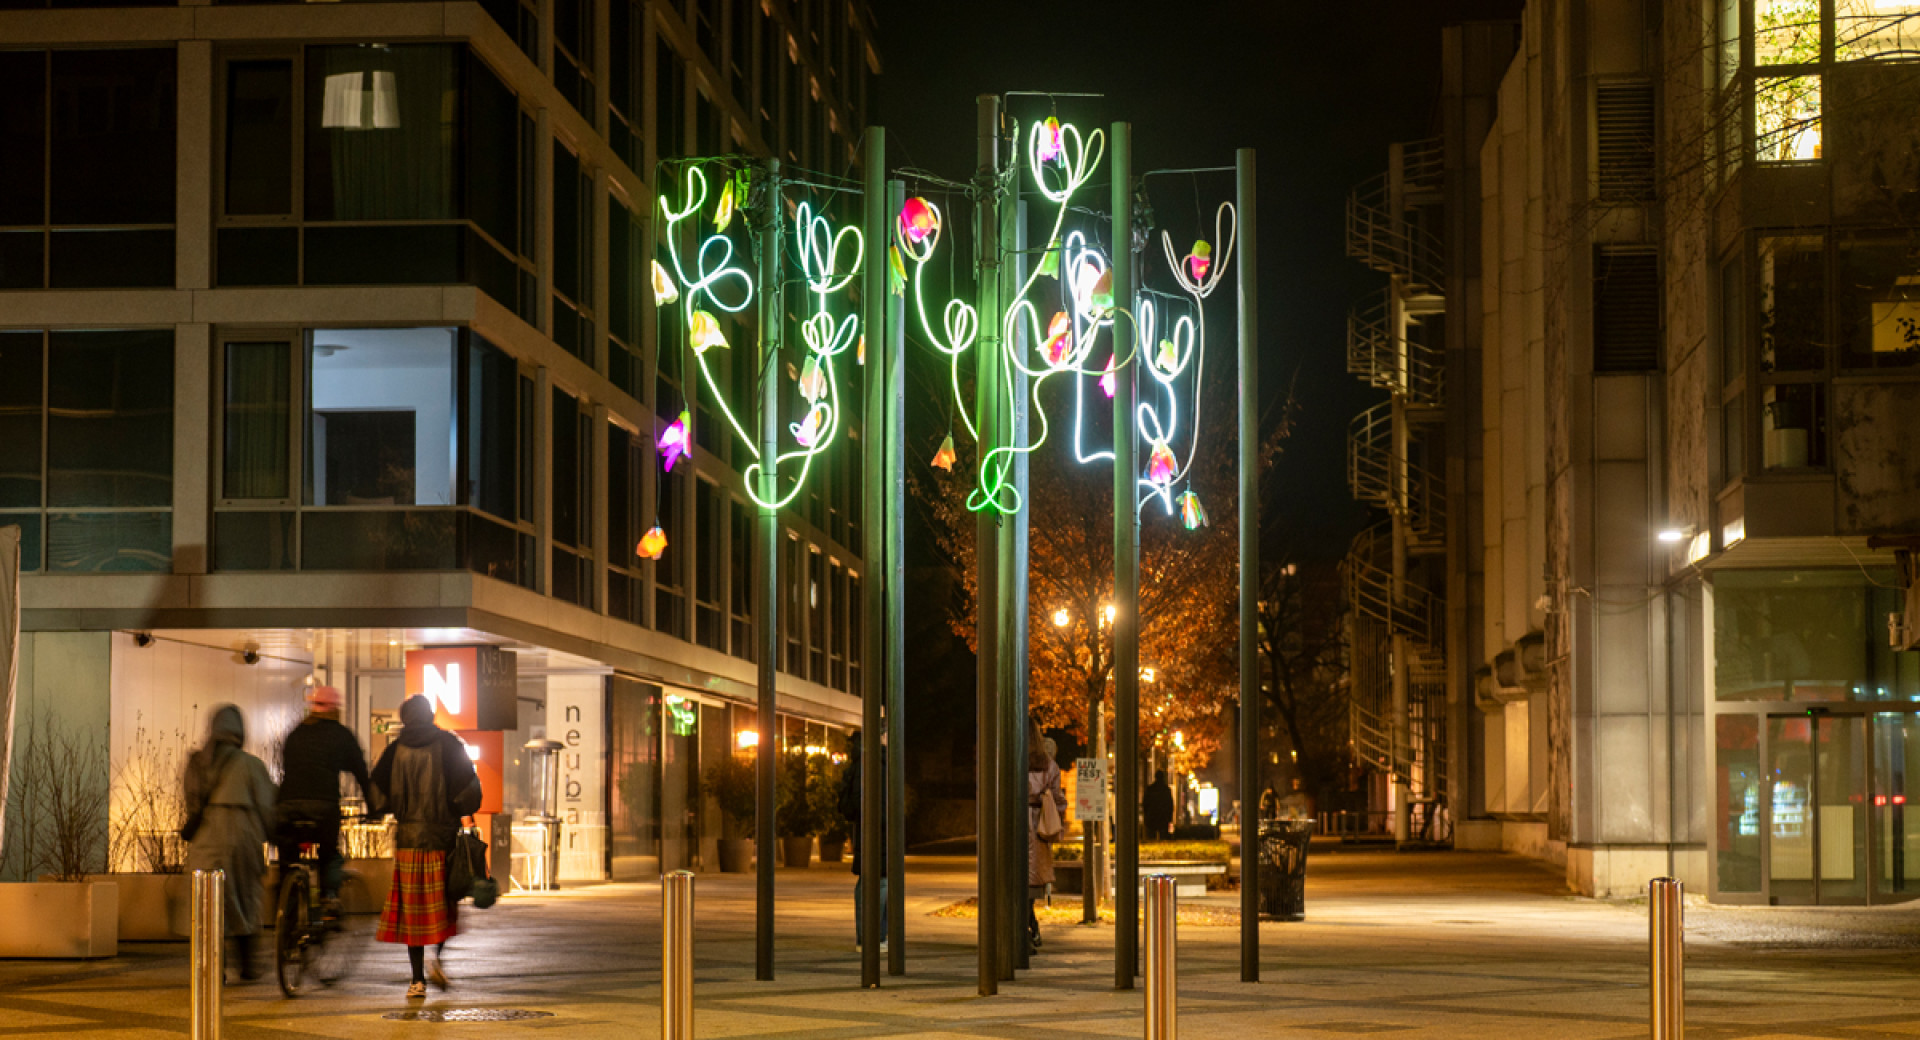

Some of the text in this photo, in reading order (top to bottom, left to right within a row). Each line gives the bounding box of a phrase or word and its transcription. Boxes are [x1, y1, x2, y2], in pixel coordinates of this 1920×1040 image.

[423, 663, 460, 714] N
[565, 704, 582, 849] neubar
[1078, 761, 1097, 769] LUV
[1078, 769, 1101, 778] FEST
